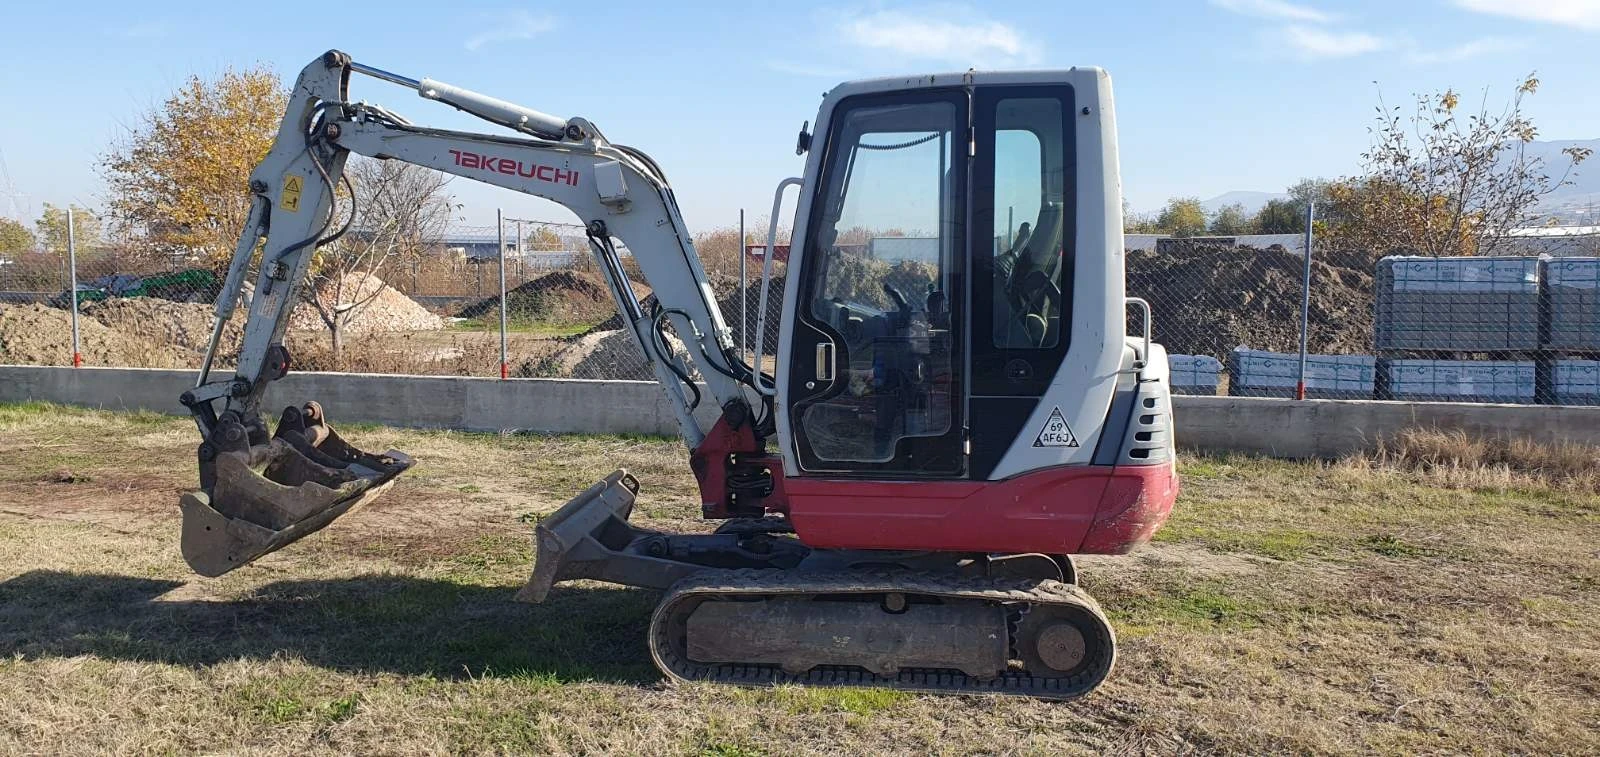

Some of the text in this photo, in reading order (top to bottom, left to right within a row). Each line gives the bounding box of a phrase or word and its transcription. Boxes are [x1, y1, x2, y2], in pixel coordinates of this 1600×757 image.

[448, 149, 579, 187] TAKEUCHI
[1050, 422, 1063, 432] 69
[1043, 433, 1069, 443] AF6J
